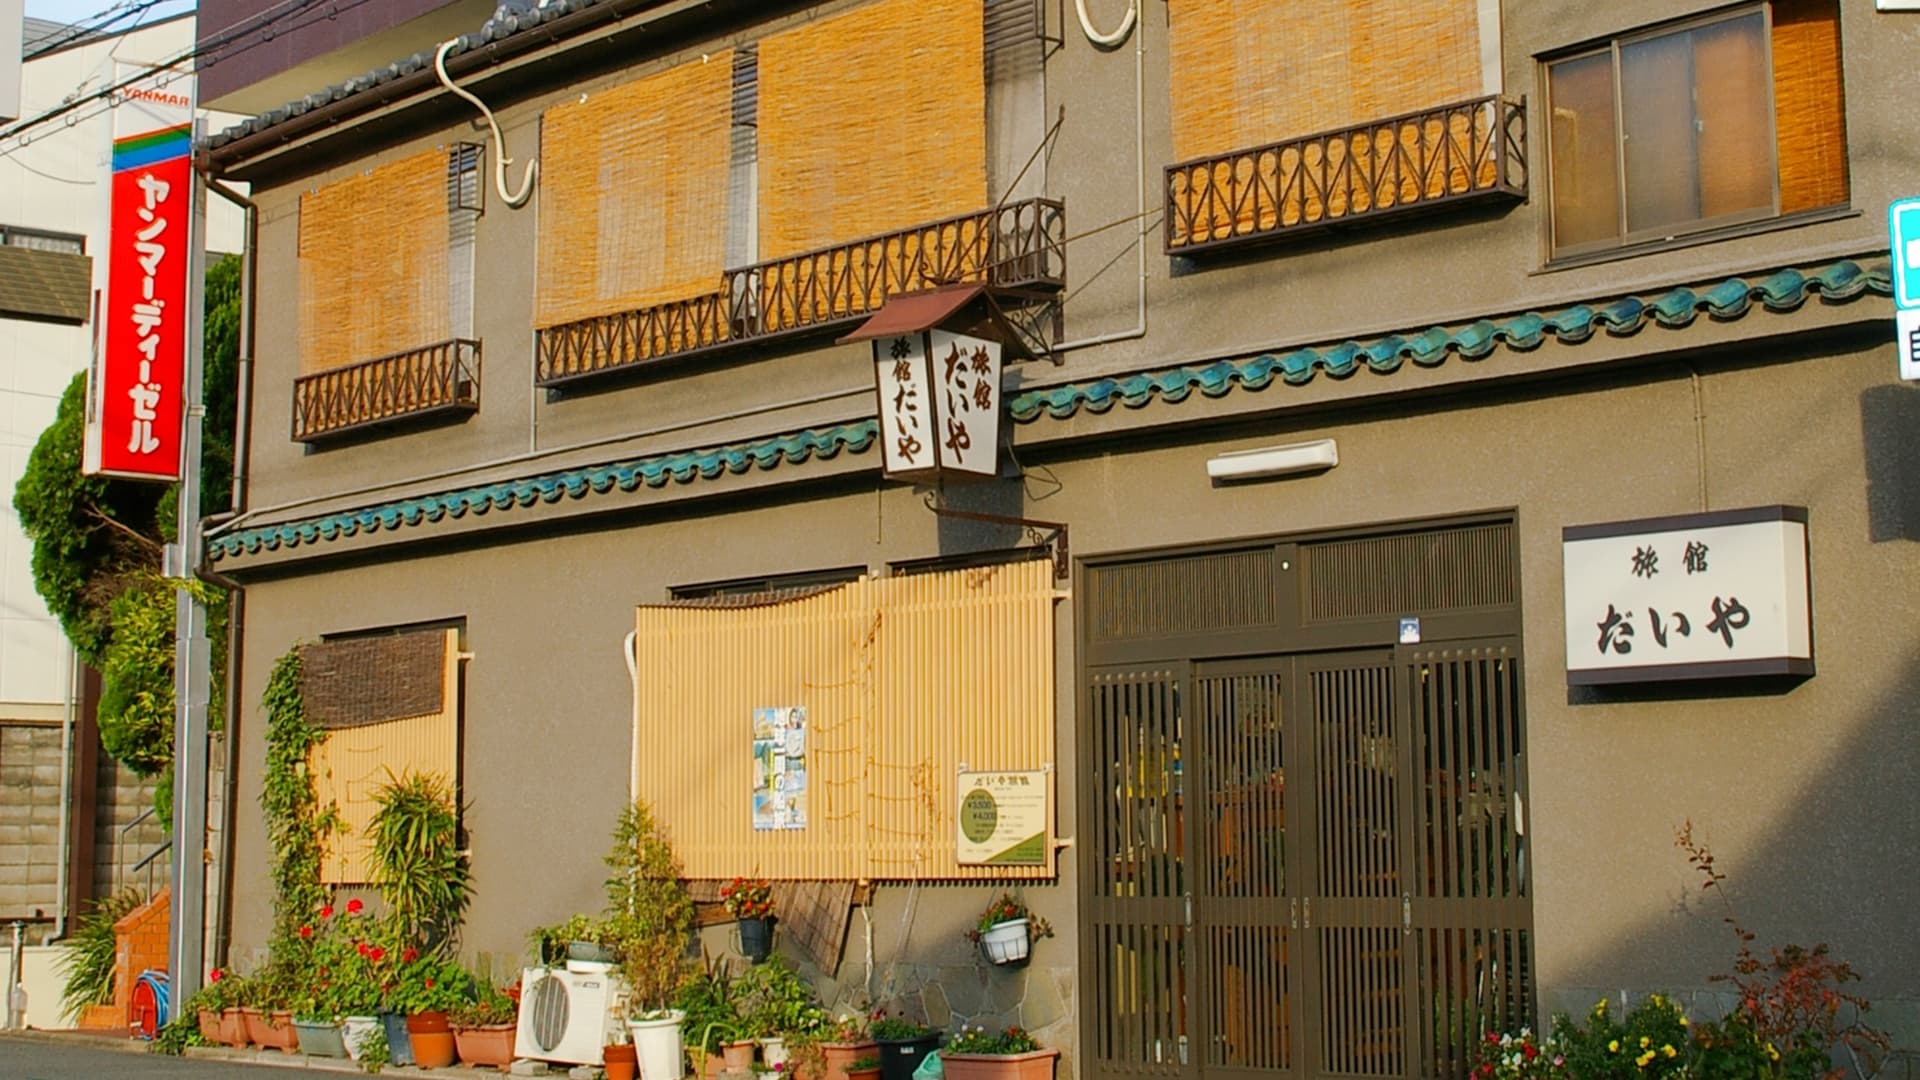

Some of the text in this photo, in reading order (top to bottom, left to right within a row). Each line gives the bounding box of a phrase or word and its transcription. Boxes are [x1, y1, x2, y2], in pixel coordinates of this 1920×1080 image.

[123, 87, 189, 107] YANMAR
[127, 173, 170, 456] ヤンマーディーゼル
[944, 340, 971, 465] だいや
[1631, 541, 1709, 579] 旅館
[1597, 596, 1750, 655] だいや
